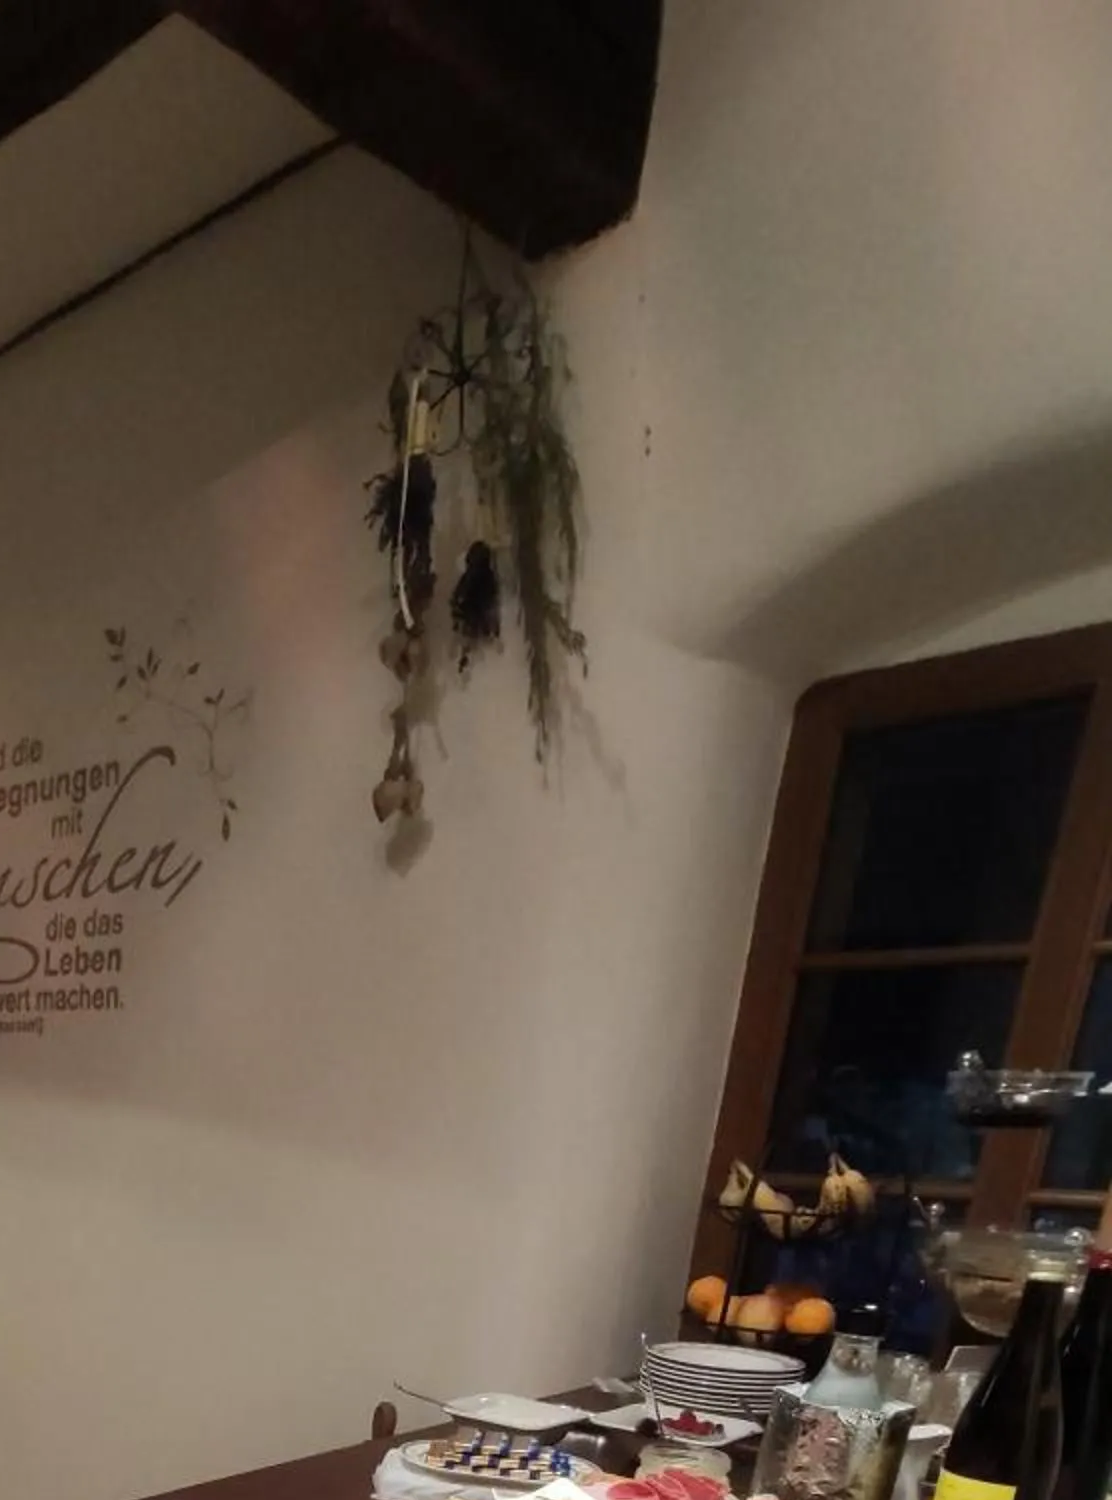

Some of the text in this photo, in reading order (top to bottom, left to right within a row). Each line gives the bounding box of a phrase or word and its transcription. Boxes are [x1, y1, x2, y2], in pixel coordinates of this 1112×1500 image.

[11, 737, 43, 768] die
[51, 806, 83, 839] mit
[45, 907, 123, 942] die das
[43, 944, 122, 976] Leben
[35, 983, 125, 1011] machen.
